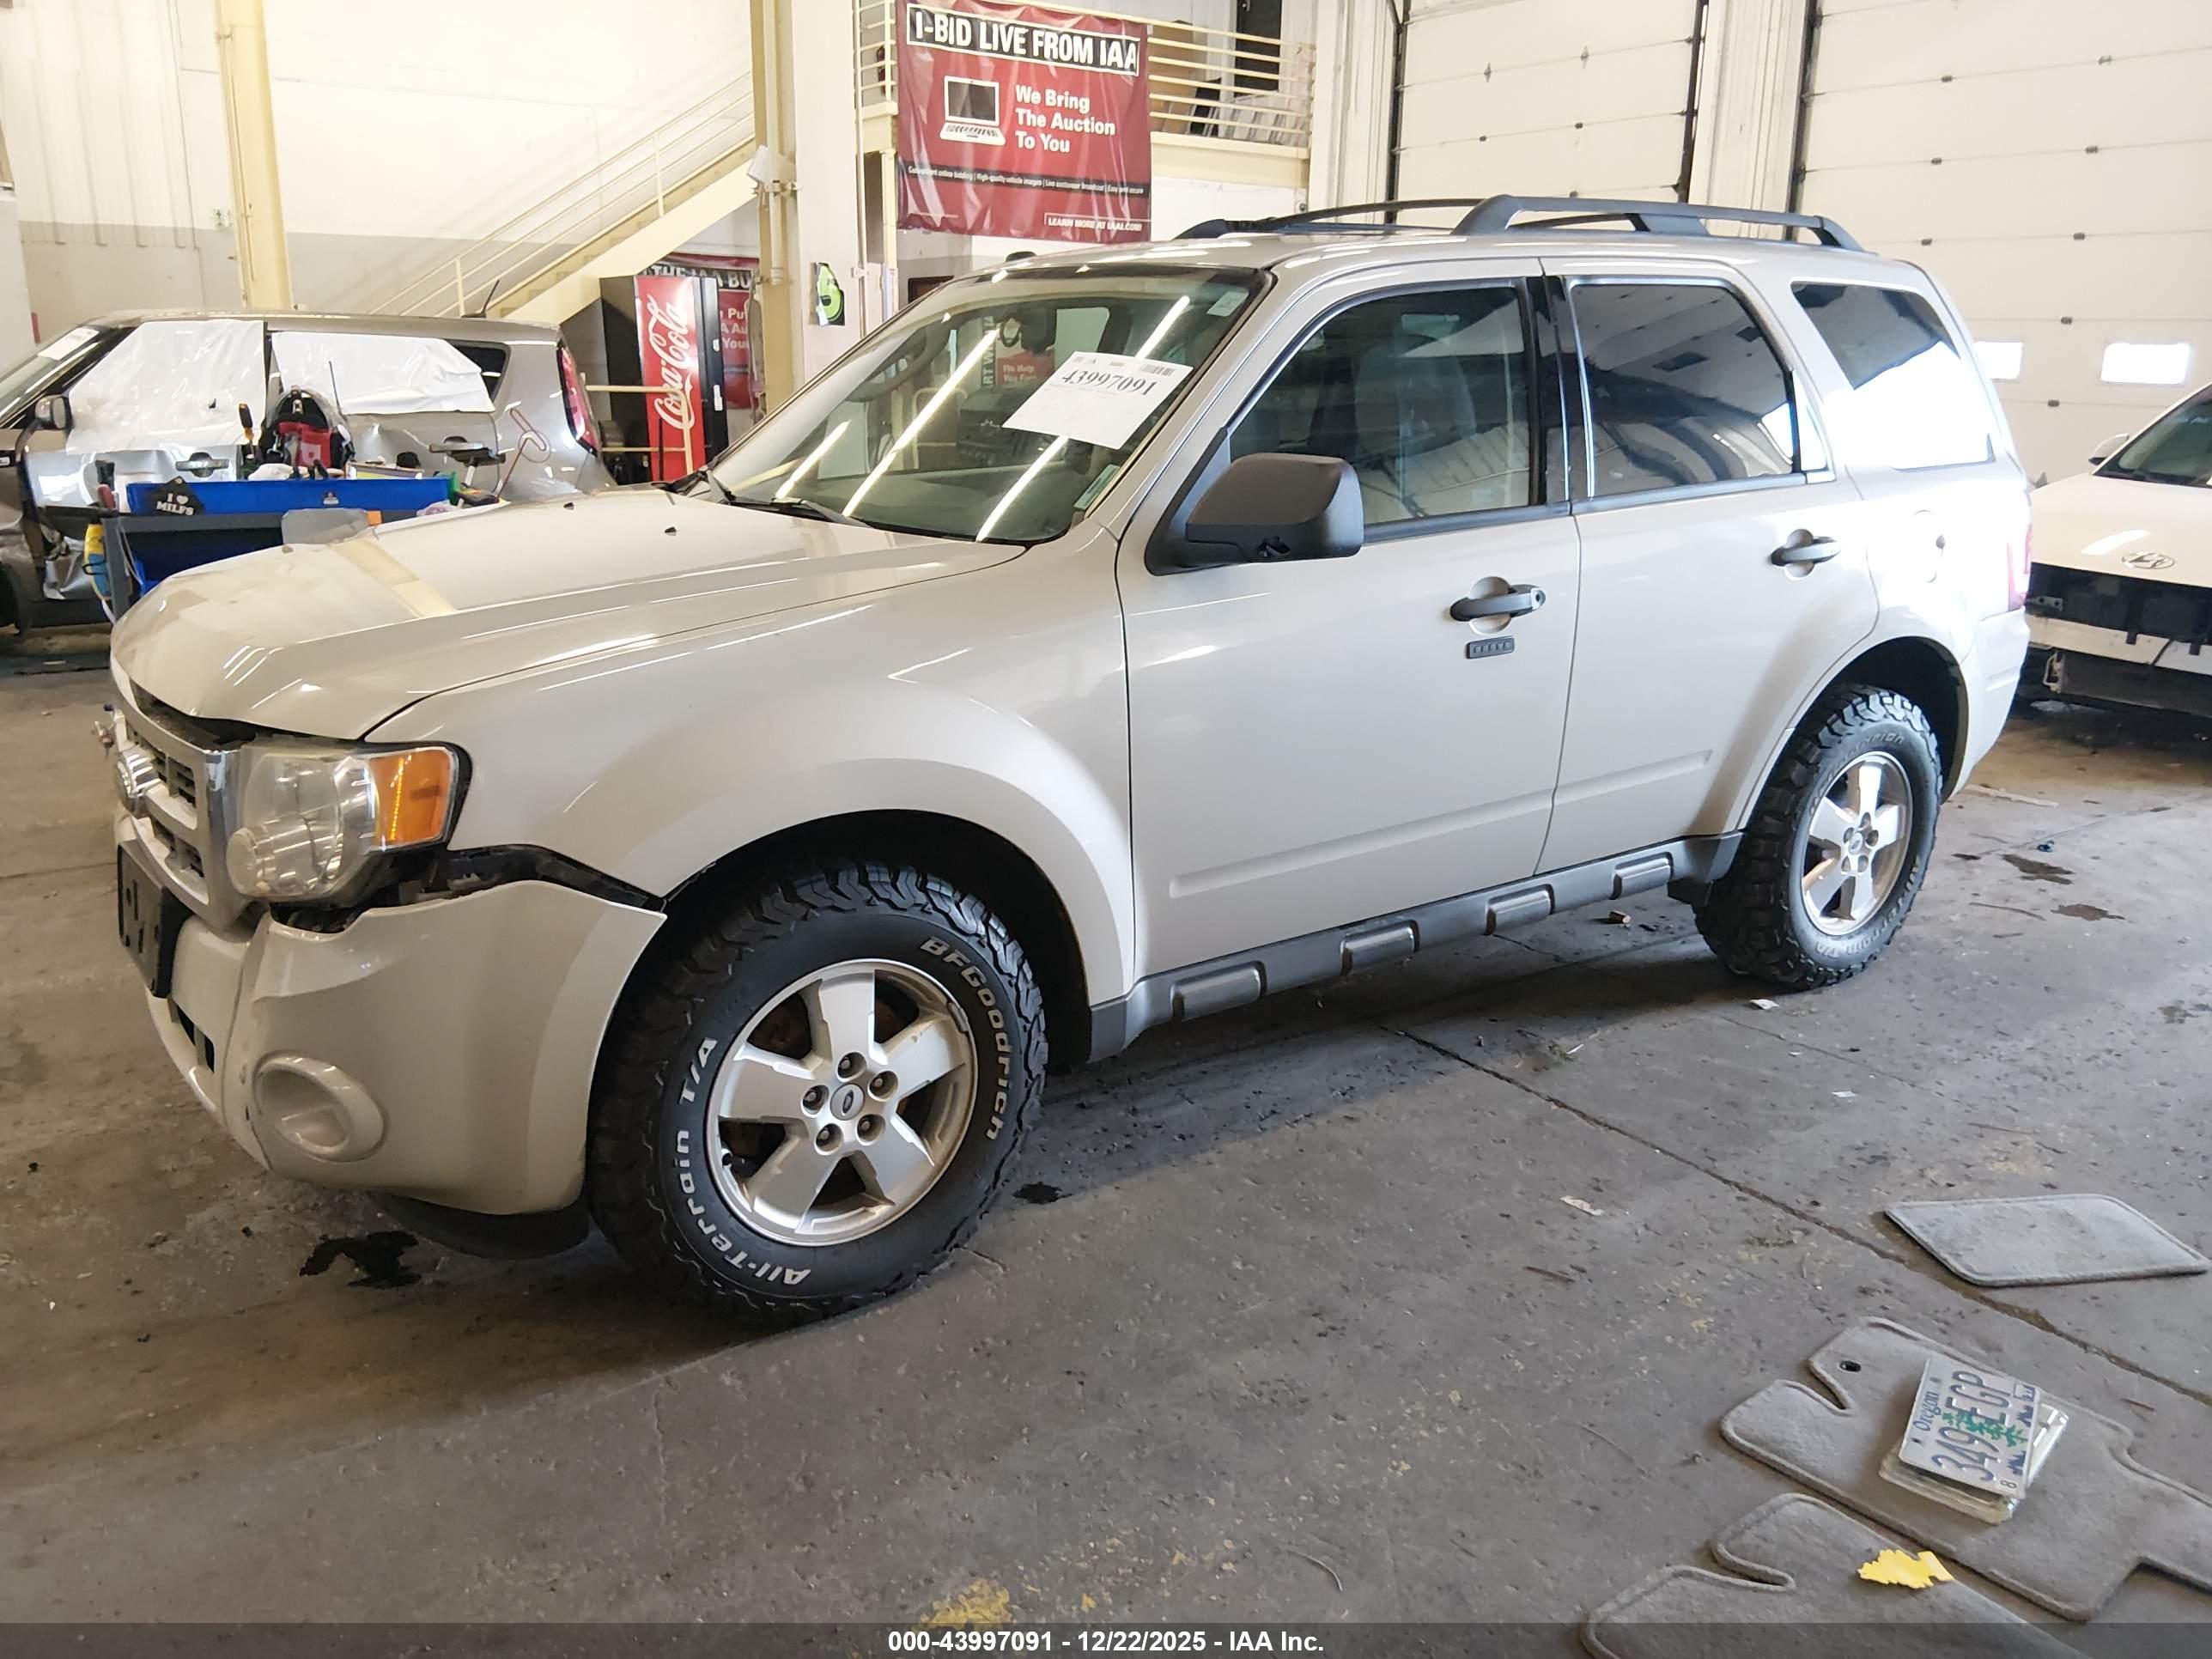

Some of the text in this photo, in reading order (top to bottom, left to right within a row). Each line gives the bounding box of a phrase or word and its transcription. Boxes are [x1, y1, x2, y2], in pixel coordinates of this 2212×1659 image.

[915, 11, 1137, 69] I-BID LIVE FROM IAA
[1016, 84, 1090, 114] We Bring
[1015, 107, 1115, 136] The Auction
[1015, 130, 1070, 153] To You
[1048, 217, 1073, 227] LEARN
[1074, 219, 1096, 229] MORE
[1096, 221, 1106, 230] AT
[727, 307, 744, 319] Pu
[647, 294, 696, 430] Coca-Cola
[1061, 369, 1158, 396] 43997091
[155, 501, 194, 516] MILFS
[920, 936, 1012, 1140] BFGoodrich
[676, 1037, 812, 1286] All-Terrain T/A
[1912, 1390, 1942, 1432] Oregon
